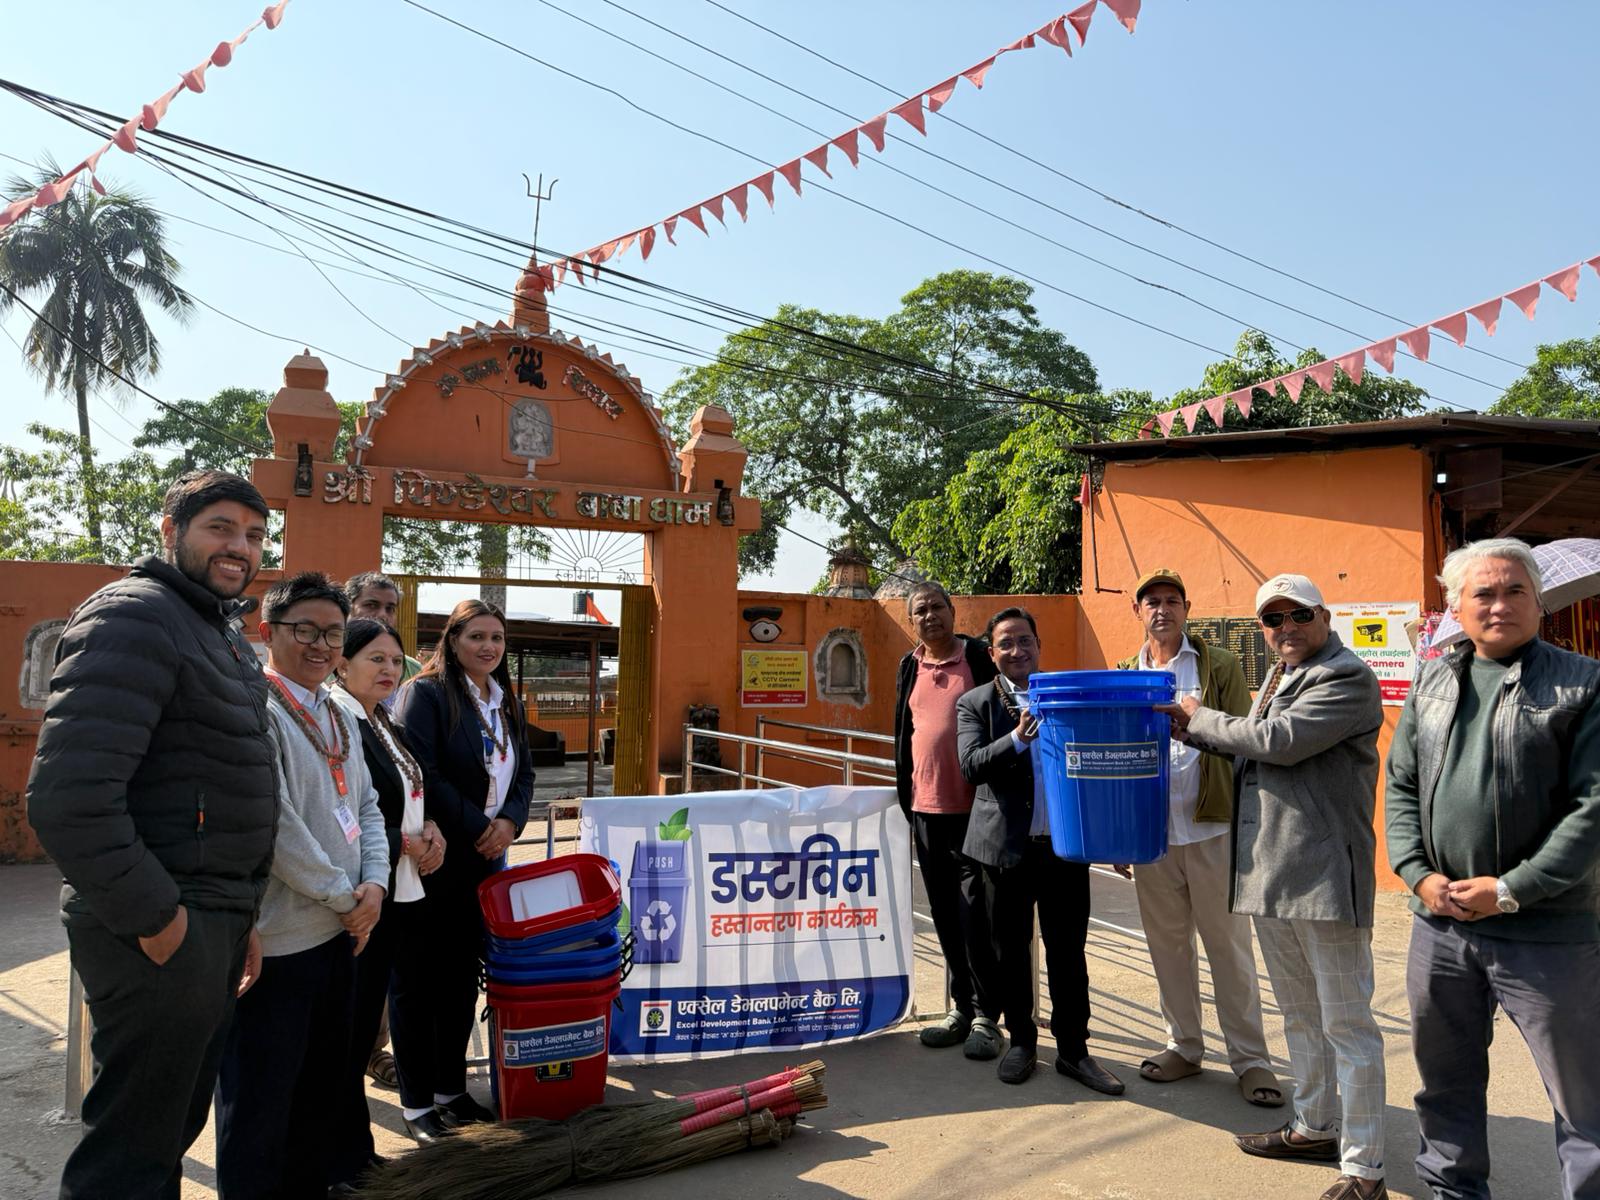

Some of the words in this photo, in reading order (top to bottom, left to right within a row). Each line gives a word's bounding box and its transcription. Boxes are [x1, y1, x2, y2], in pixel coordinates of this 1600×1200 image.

[322, 465, 376, 504] श्री
[576, 490, 643, 522] बाबा
[649, 496, 713, 527] धाम
[1366, 659, 1405, 668] Camera
[648, 856, 673, 869] PUSH
[708, 832, 880, 904] डस्टविन
[710, 911, 804, 937] हस्तान्तरण
[807, 902, 878, 930] कार्यक्रम
[677, 995, 727, 1016] एक्सेल
[730, 991, 810, 1013] डेभलपमेन्ट
[812, 988, 838, 1008] बैंक
[841, 987, 862, 1006] लि.
[676, 1021, 698, 1029] Excel
[700, 1018, 751, 1029] Development
[752, 1017, 772, 1025] Bank
[773, 1016, 788, 1024] Ltd.
